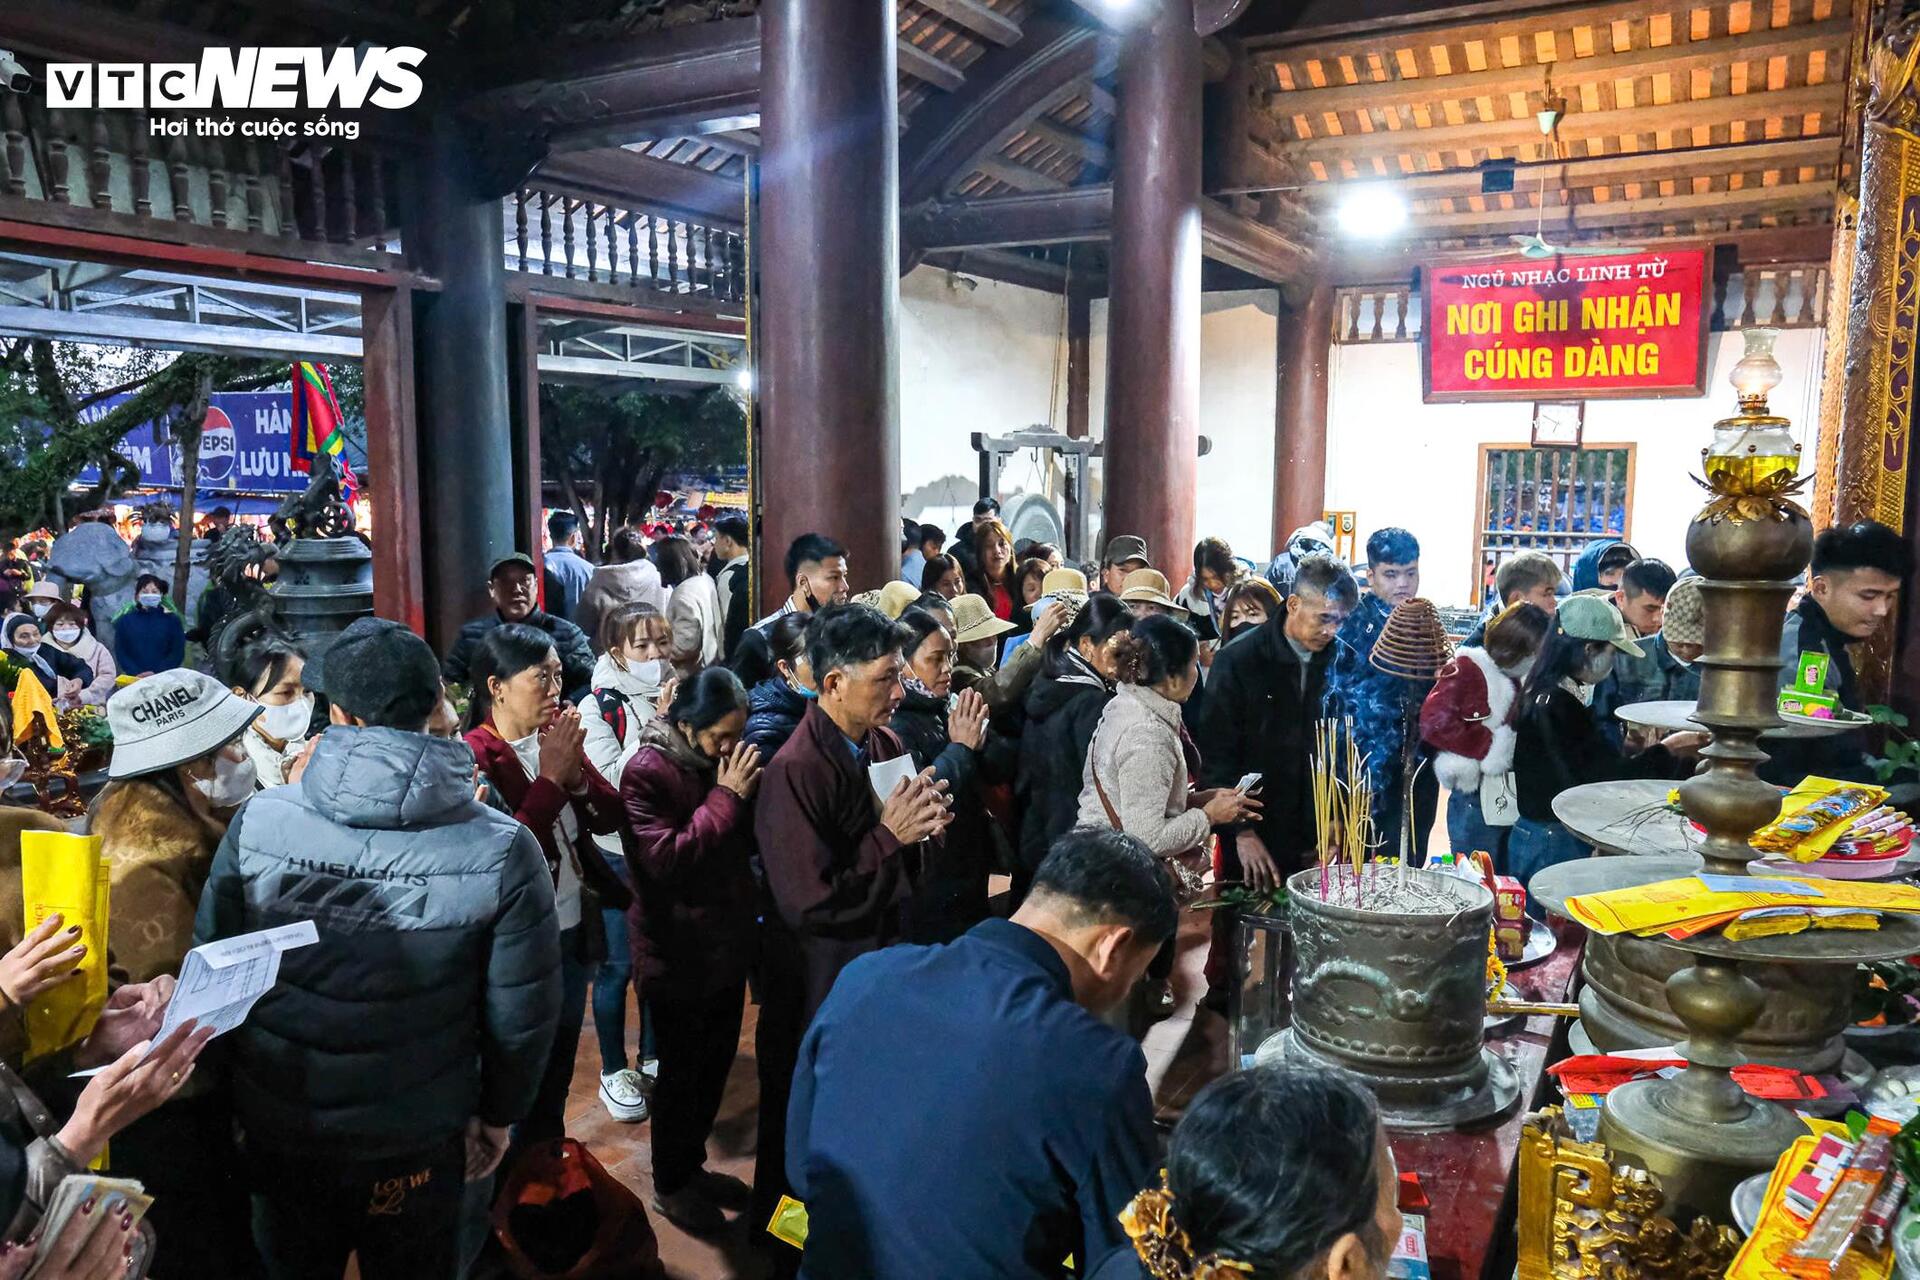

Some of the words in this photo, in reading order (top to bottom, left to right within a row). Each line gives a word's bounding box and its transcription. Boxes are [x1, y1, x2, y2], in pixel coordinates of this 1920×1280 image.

[1462, 269, 1505, 289] NGŨ
[1511, 267, 1570, 289] NHẠC
[1576, 263, 1631, 283] LINH
[1637, 257, 1669, 279] TỪ
[1446, 301, 1502, 336] NƠI
[1513, 299, 1568, 333] GHI
[1581, 286, 1681, 335] NHẬN
[1464, 341, 1553, 380] CÚNG
[1563, 338, 1659, 379] DÀNG
[255, 401, 292, 434] HÀN
[202, 435, 234, 452] EPSI
[240, 447, 280, 477] LƯU
[132, 686, 198, 723] CHANEL
[155, 708, 186, 728] PARIS
